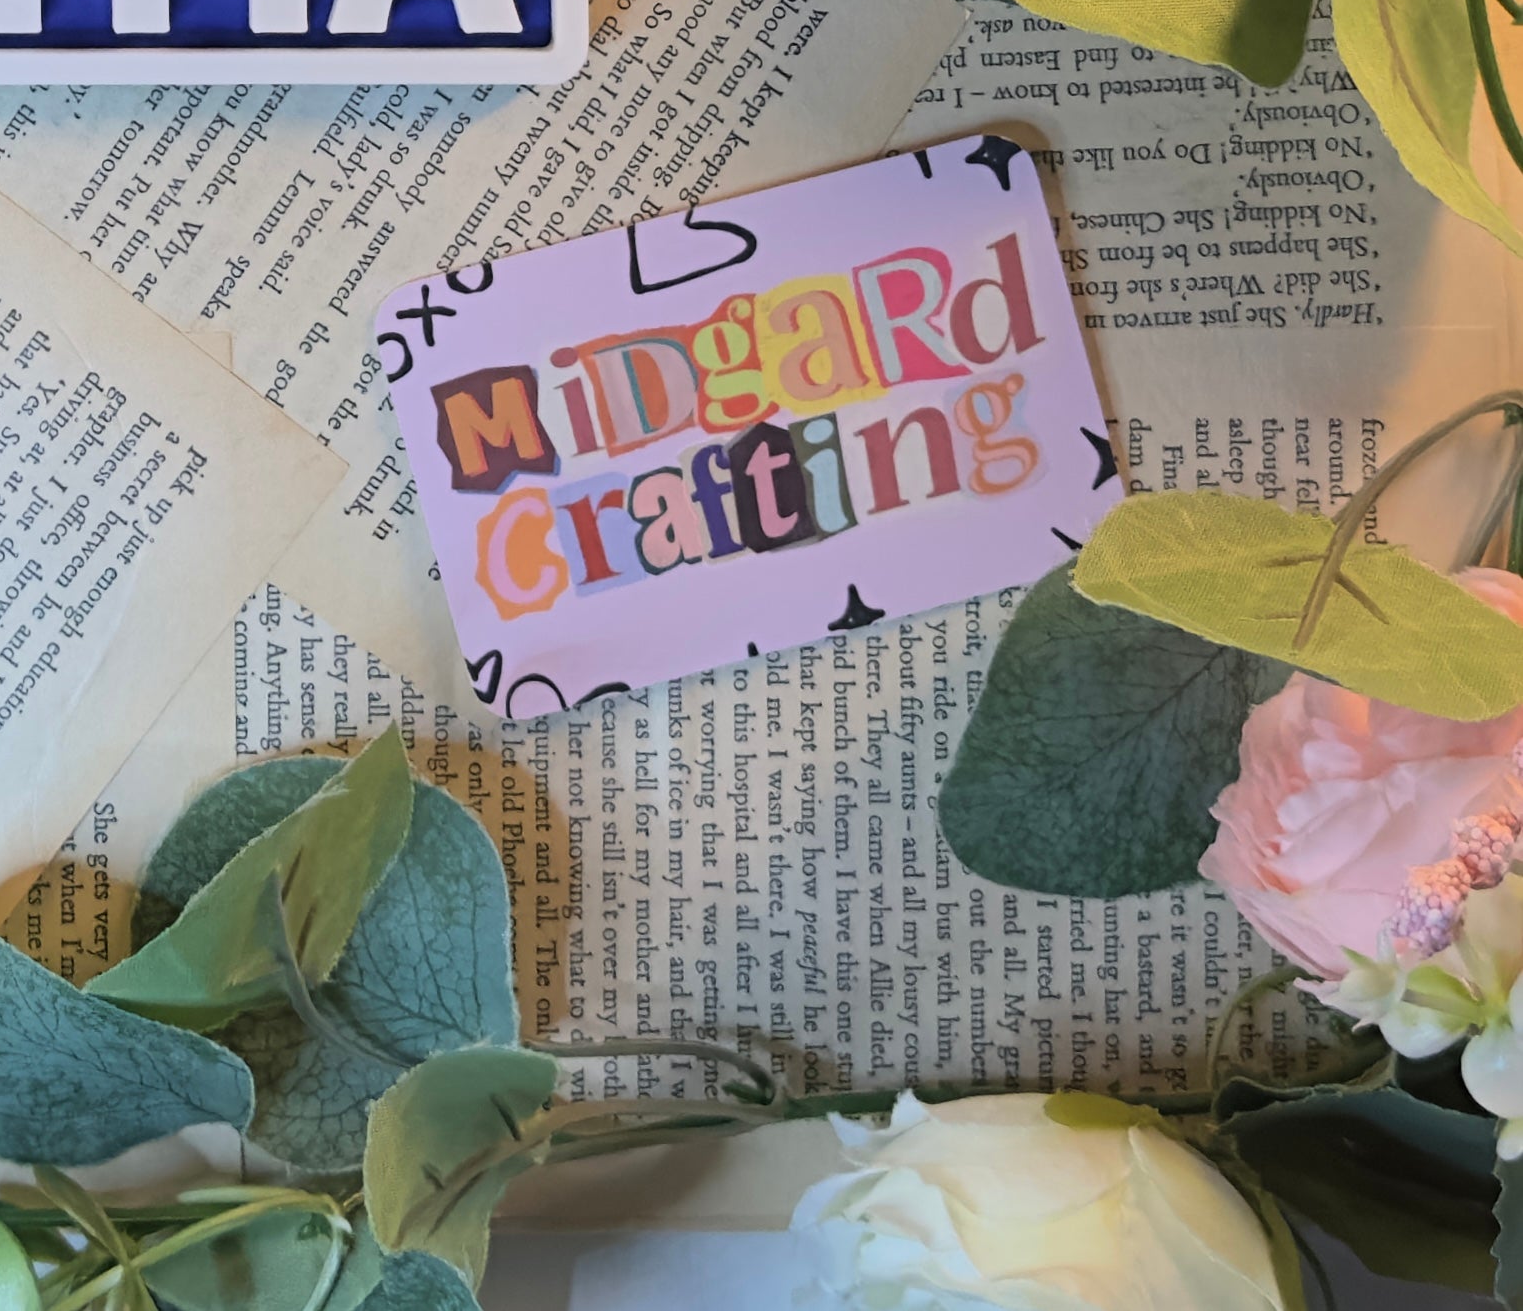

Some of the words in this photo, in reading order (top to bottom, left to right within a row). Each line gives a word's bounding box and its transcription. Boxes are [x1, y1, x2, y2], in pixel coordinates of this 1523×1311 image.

[783, 9, 829, 57] were.
[772, 64, 793, 82] I
[739, 80, 784, 128] kept
[395, 112, 471, 214] somebody
[291, 198, 334, 249] voice
[1069, 211, 1166, 237] Chinese,
[1173, 208, 1215, 233] She
[1224, 199, 1322, 231] kidding!
[328, 221, 396, 317] answered
[1097, 245, 1155, 270] from
[1162, 243, 1191, 268] be
[1197, 242, 1222, 259] to
[1229, 231, 1322, 262] happens
[258, 249, 295, 295] said.
[298, 321, 331, 355] the
[38, 371, 105, 442] driving
[19, 442, 45, 465] at,
[168, 444, 208, 496] pick
[1229, 417, 1253, 485] asleep
[3, 470, 24, 494] at
[481, 372, 1046, 607] Crafting
[144, 498, 173, 526] up
[116, 519, 155, 566] just
[59, 566, 118, 639] enough
[733, 668, 750, 692] to
[799, 645, 823, 690] that
[865, 635, 890, 699] there.
[259, 641, 298, 754] Anything
[733, 702, 757, 743] this
[792, 700, 823, 752] kept
[859, 708, 891, 771] They
[726, 753, 759, 843] hospital
[793, 763, 823, 836] saying
[867, 778, 892, 806] all
[868, 814, 883, 875] came
[735, 852, 760, 895] and
[802, 846, 827, 900] how
[735, 904, 760, 932] all
[869, 882, 893, 948] when
[736, 941, 761, 994] after
[794, 909, 827, 995] peaceful
[869, 957, 894, 1012] Allie
[736, 1004, 758, 1014] I
[803, 1004, 827, 1032] he
[867, 1020, 894, 1078] died,
